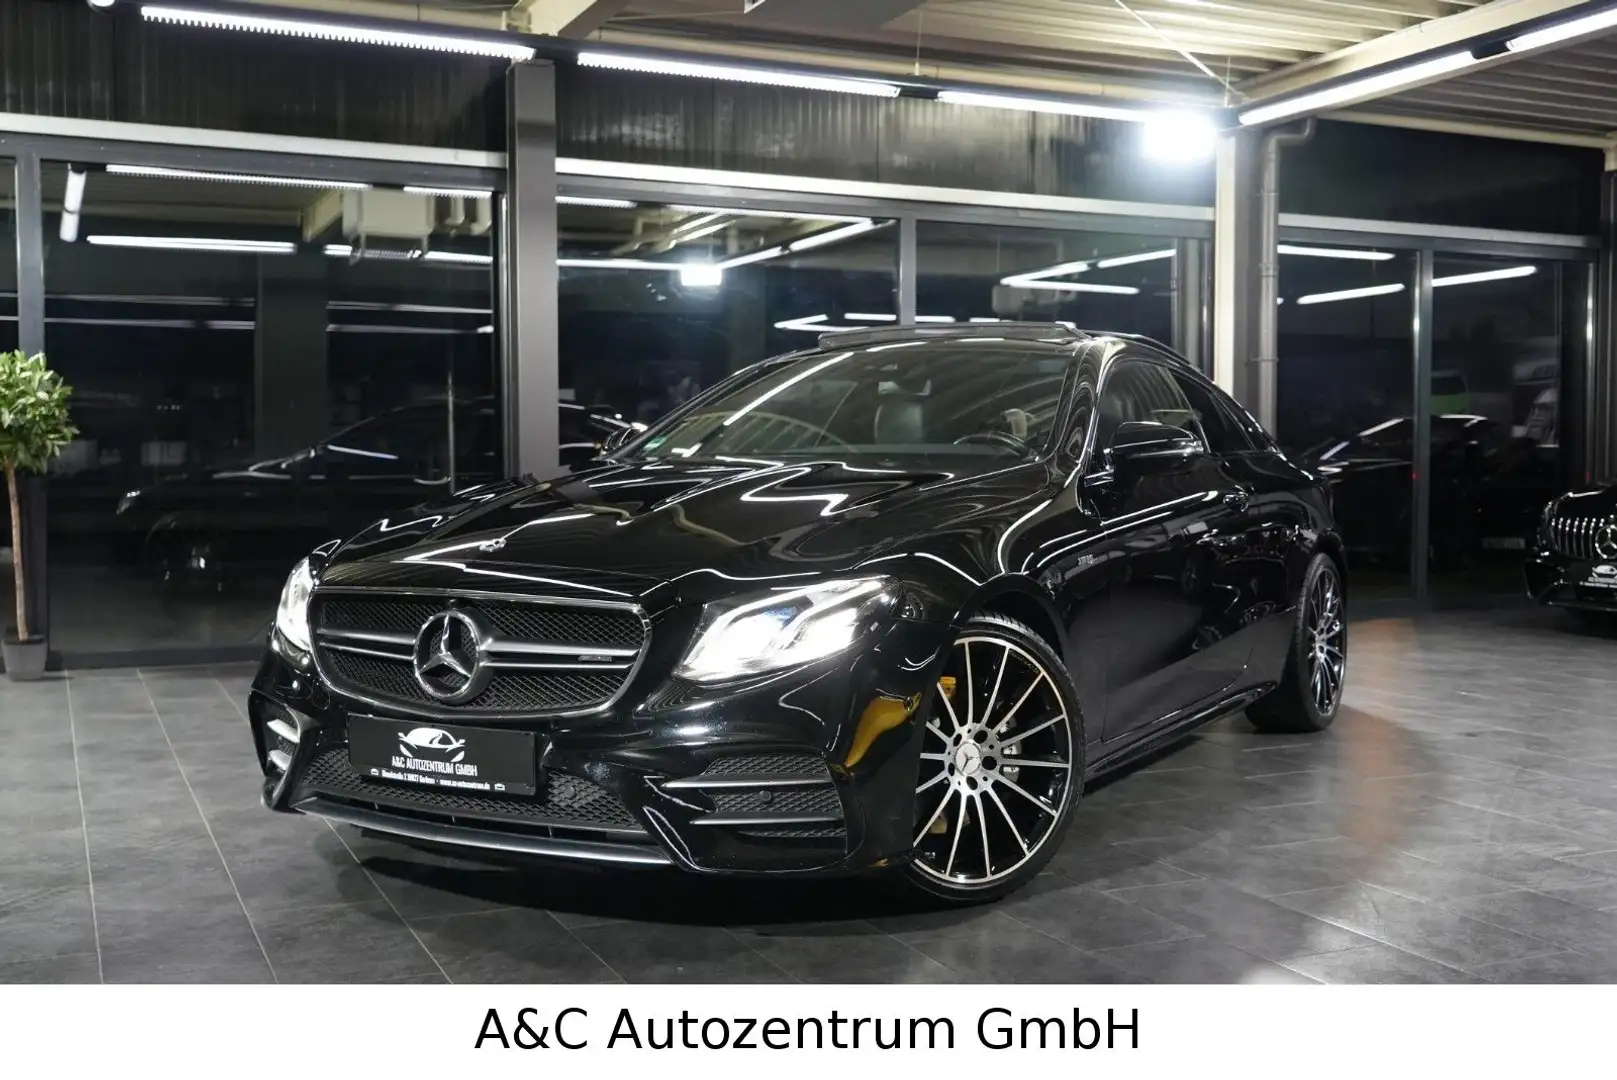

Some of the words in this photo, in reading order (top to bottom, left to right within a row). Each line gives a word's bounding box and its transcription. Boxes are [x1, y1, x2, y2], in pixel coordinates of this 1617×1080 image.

[392, 755, 405, 768] A&C
[406, 758, 454, 775] AUTOZENTRUM
[455, 763, 478, 777] GMBH
